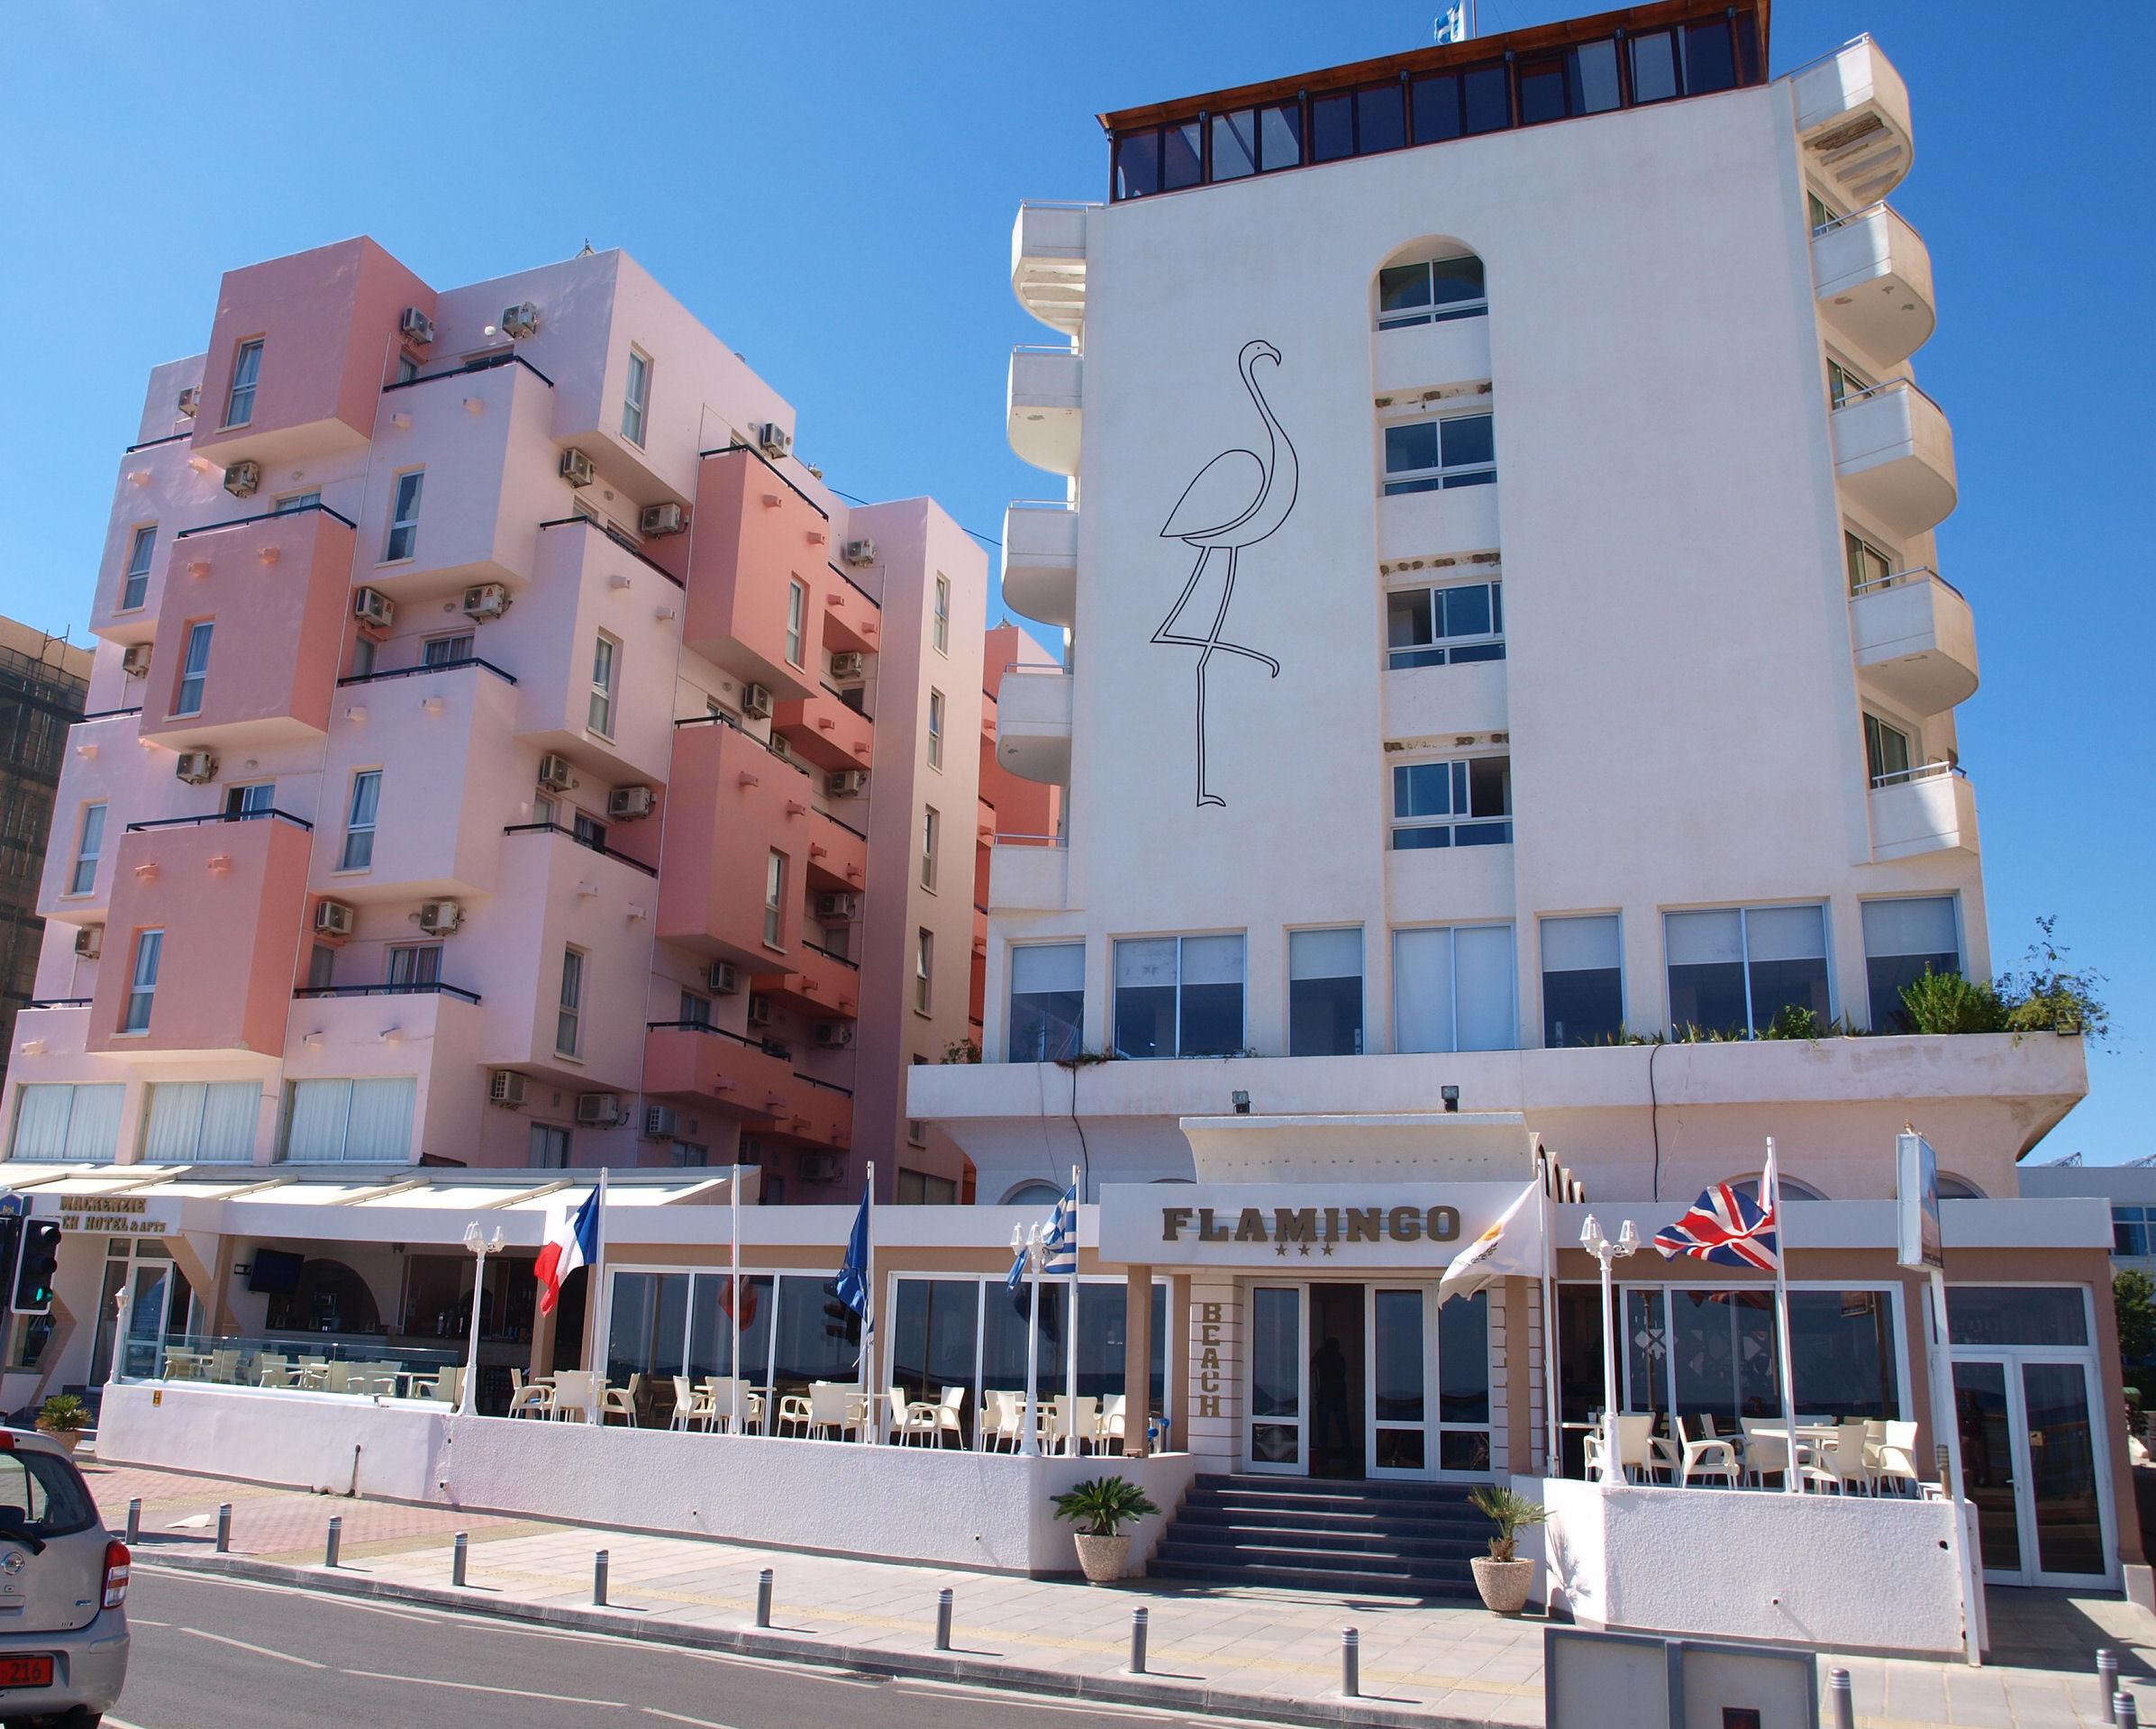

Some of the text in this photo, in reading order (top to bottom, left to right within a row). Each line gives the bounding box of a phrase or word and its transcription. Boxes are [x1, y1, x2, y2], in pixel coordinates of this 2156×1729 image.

[59, 1196, 147, 1213] MACKENZIE
[85, 1216, 129, 1232] HOTEL
[130, 1221, 139, 1233] &
[139, 1221, 166, 1233] APTS
[1162, 1206, 1460, 1242] FLAMINGO
[1199, 1303, 1223, 1417] BEACH
